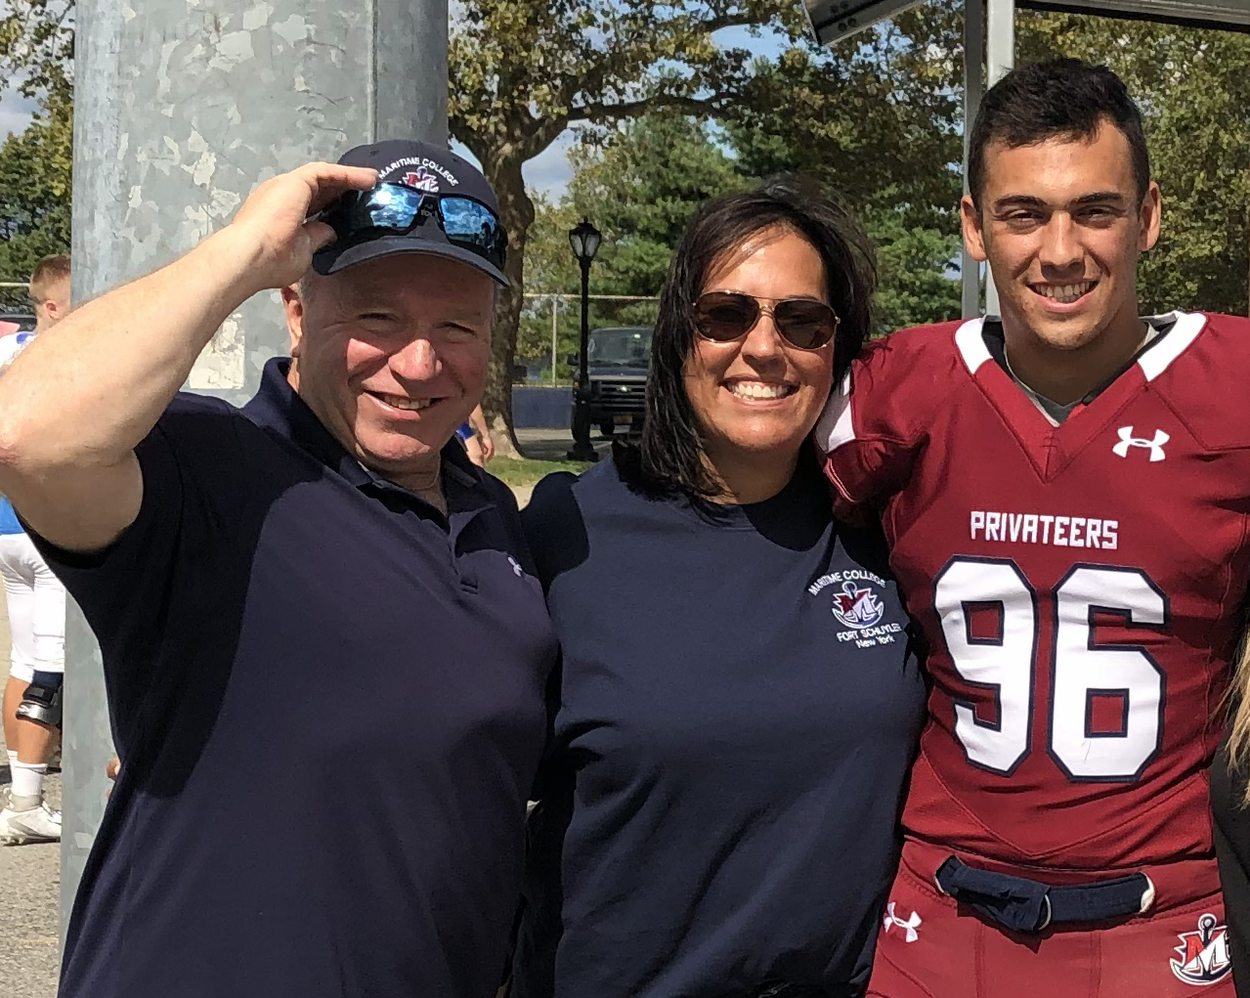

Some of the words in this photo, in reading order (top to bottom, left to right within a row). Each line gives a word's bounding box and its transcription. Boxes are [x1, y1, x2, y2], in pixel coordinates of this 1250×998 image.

[378, 157, 420, 179] MARITIME
[422, 158, 459, 187] COLLEGE
[970, 510, 1119, 550] PRIVATEERS
[808, 572, 842, 596] MARITIME
[843, 570, 886, 588] COLLEGE
[836, 630, 860, 642] FORT
[855, 638, 876, 648] New
[875, 634, 895, 645] York
[931, 554, 1171, 783] 96
